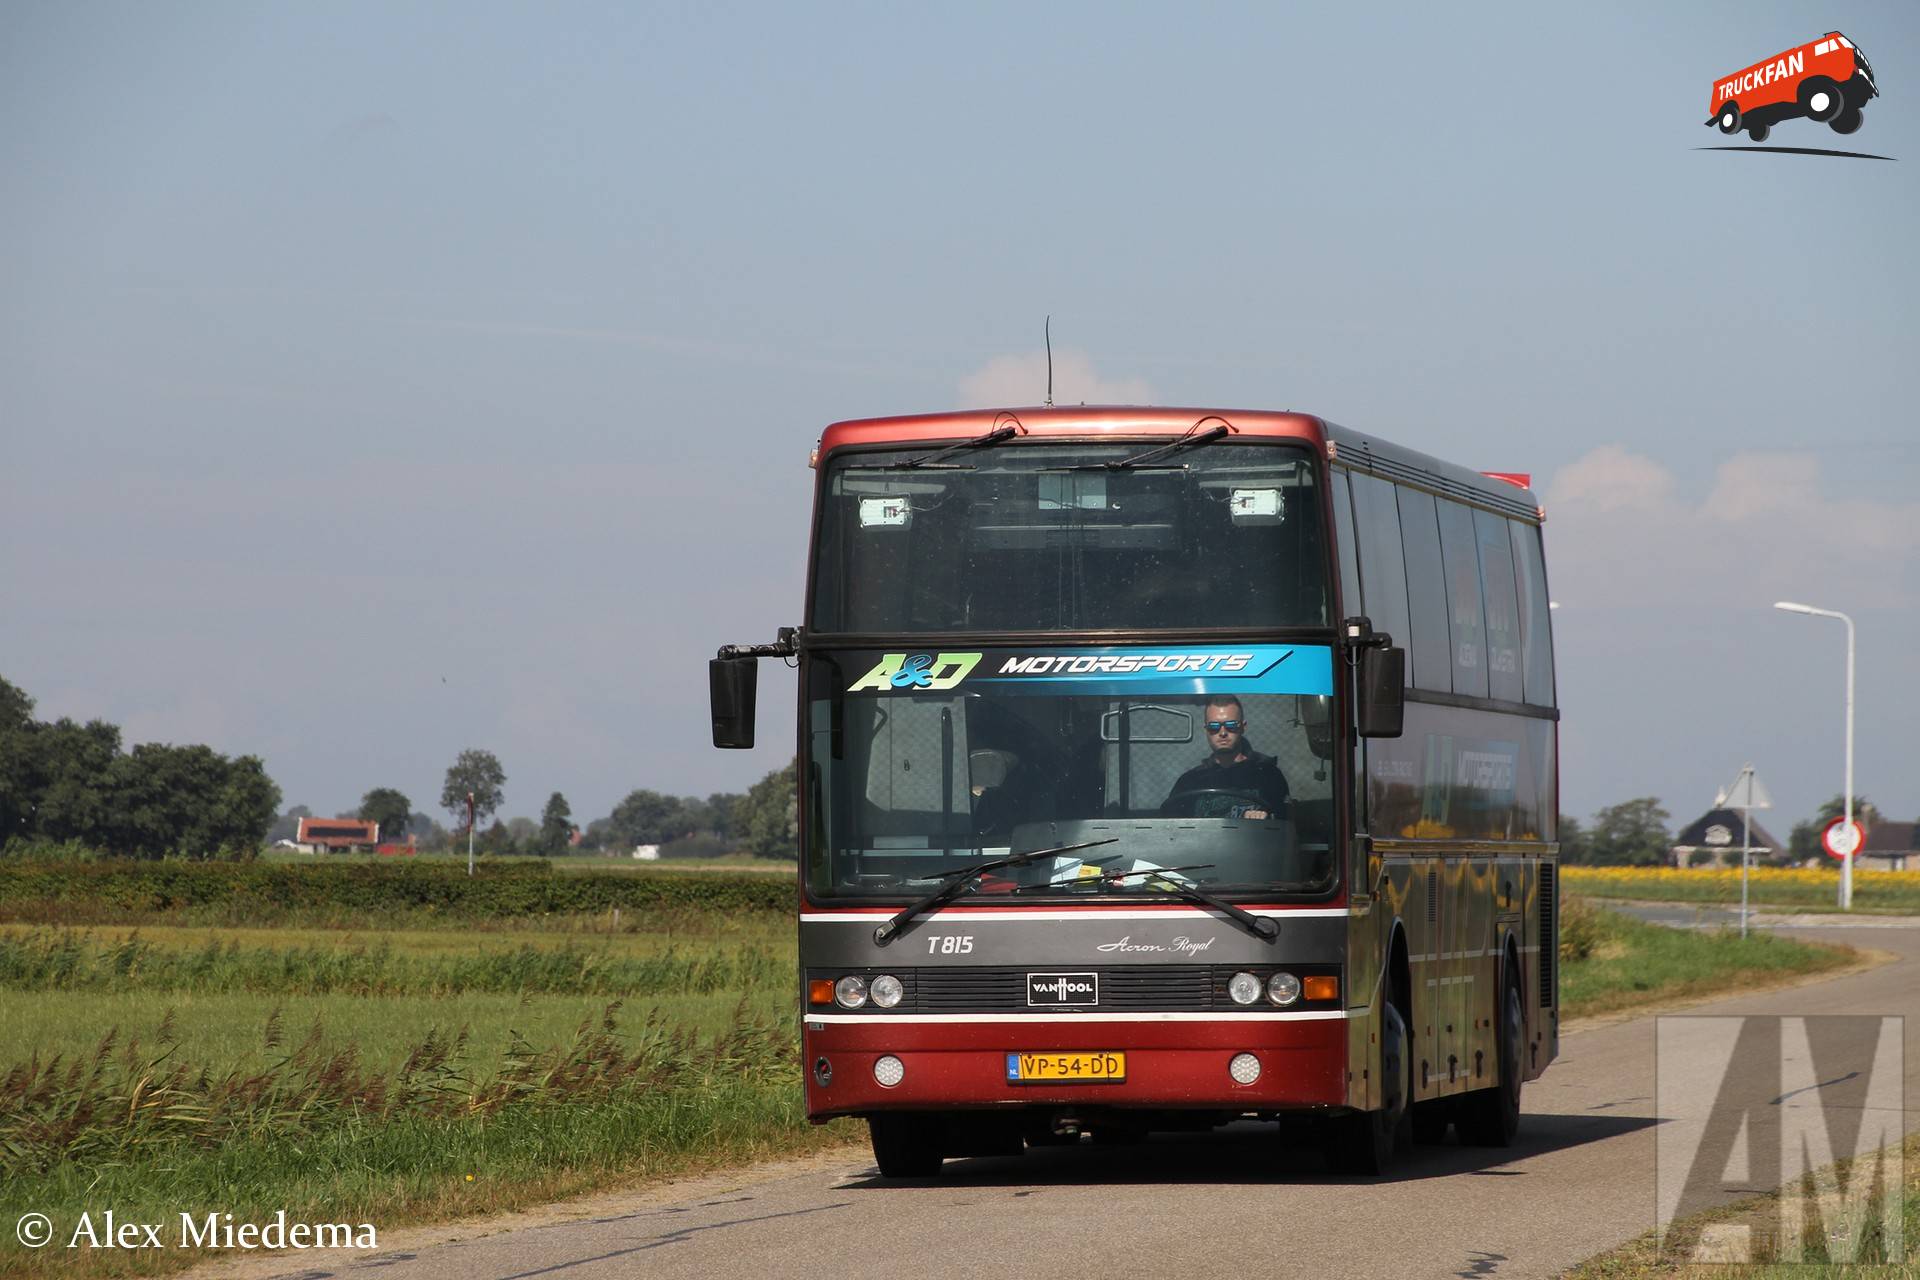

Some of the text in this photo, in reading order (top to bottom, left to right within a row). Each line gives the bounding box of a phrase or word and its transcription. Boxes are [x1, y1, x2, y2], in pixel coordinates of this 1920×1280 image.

[847, 653, 1255, 692] A&D MOTORSPORTS
[1168, 935, 1216, 957] Royal
[1024, 1057, 1118, 1075] VP-54-DD
